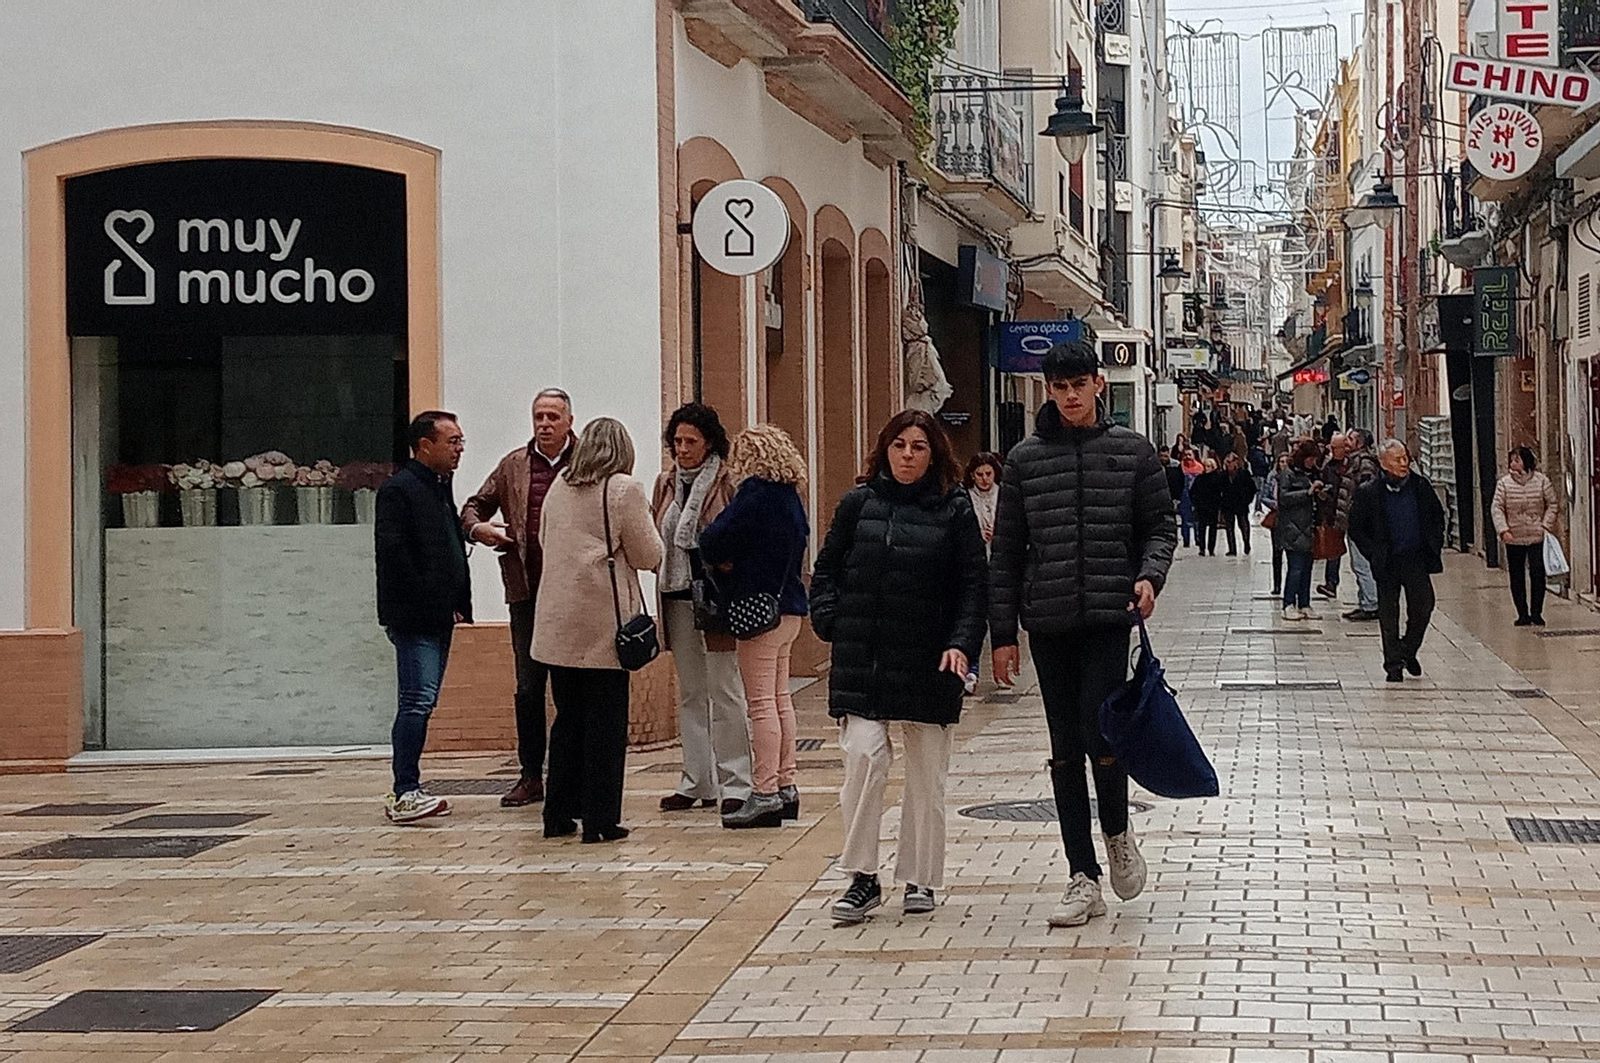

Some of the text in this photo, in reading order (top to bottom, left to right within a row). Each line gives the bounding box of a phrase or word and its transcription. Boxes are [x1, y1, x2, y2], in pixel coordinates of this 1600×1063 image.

[1453, 61, 1589, 102] CHINO
[1498, 107, 1540, 148] DIVINO
[179, 218, 301, 261] muy
[179, 257, 375, 304] mucho
[1009, 324, 1038, 333] centro
